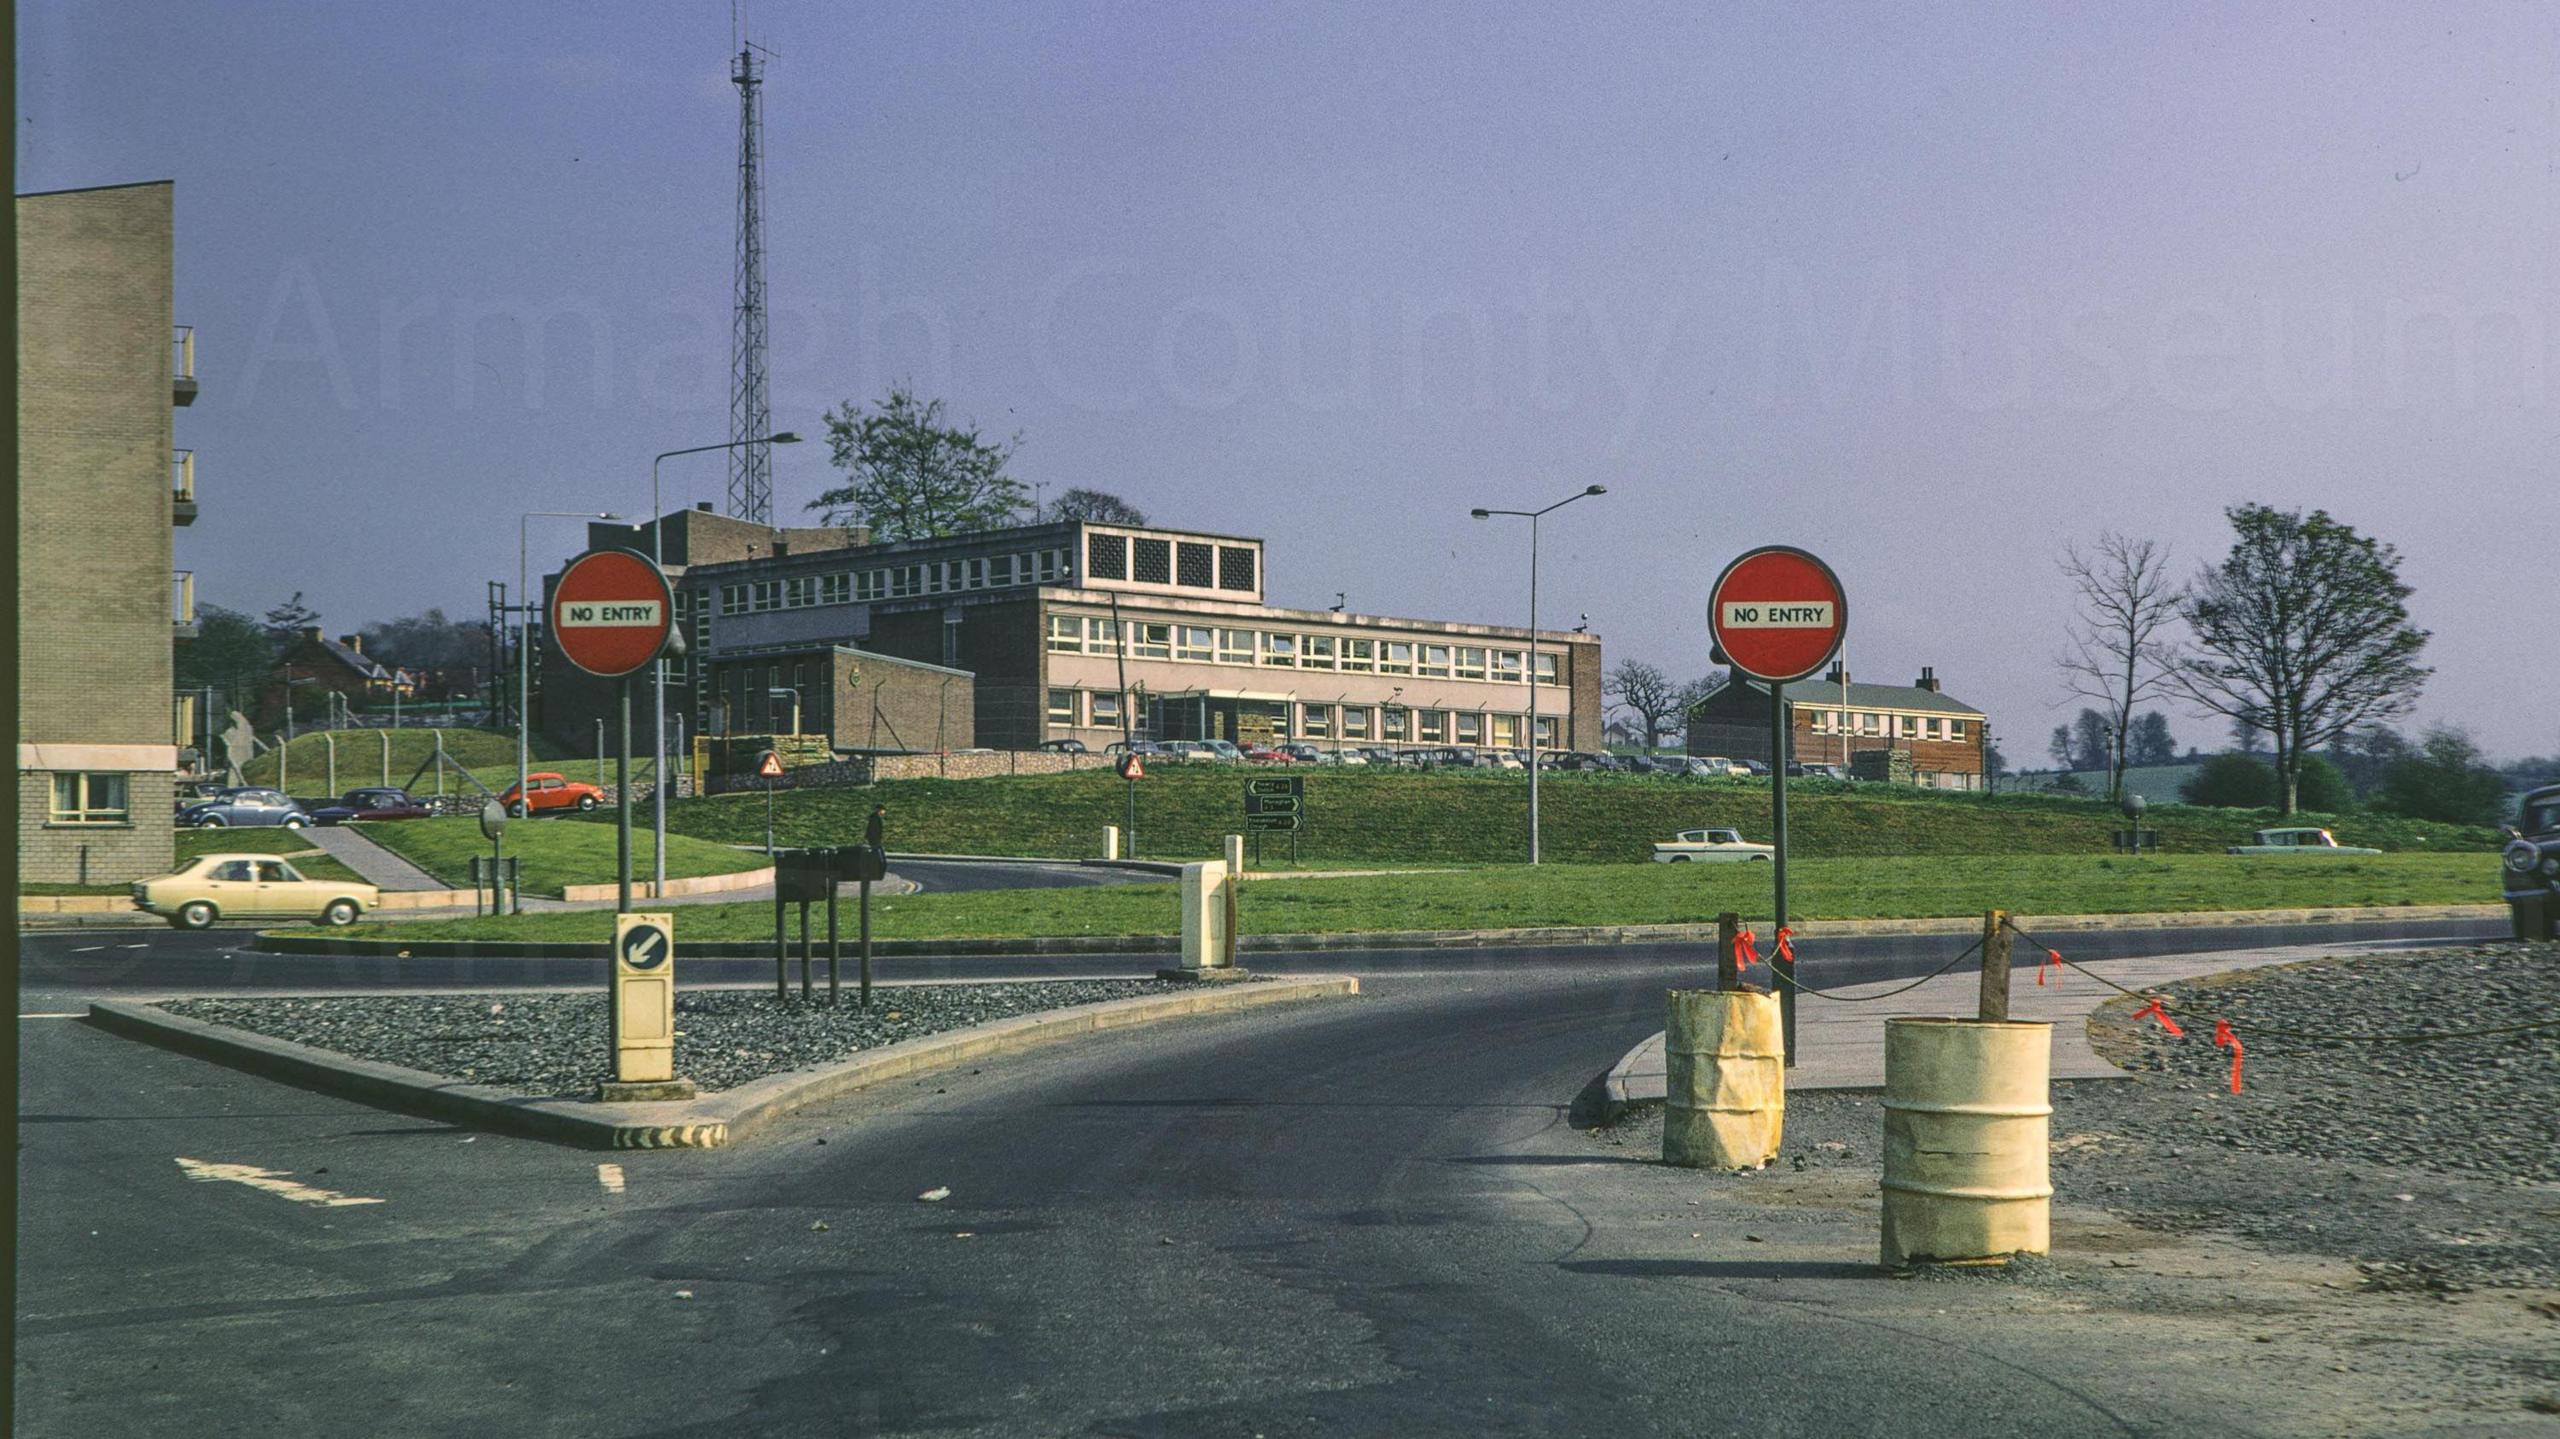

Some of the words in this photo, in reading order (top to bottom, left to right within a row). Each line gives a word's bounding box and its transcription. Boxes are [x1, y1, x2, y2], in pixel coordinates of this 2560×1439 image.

[571, 607, 593, 621] NO
[602, 606, 653, 621] ENTRY
[1734, 608, 1758, 622] NO
[1769, 608, 1824, 622] ENTRY
